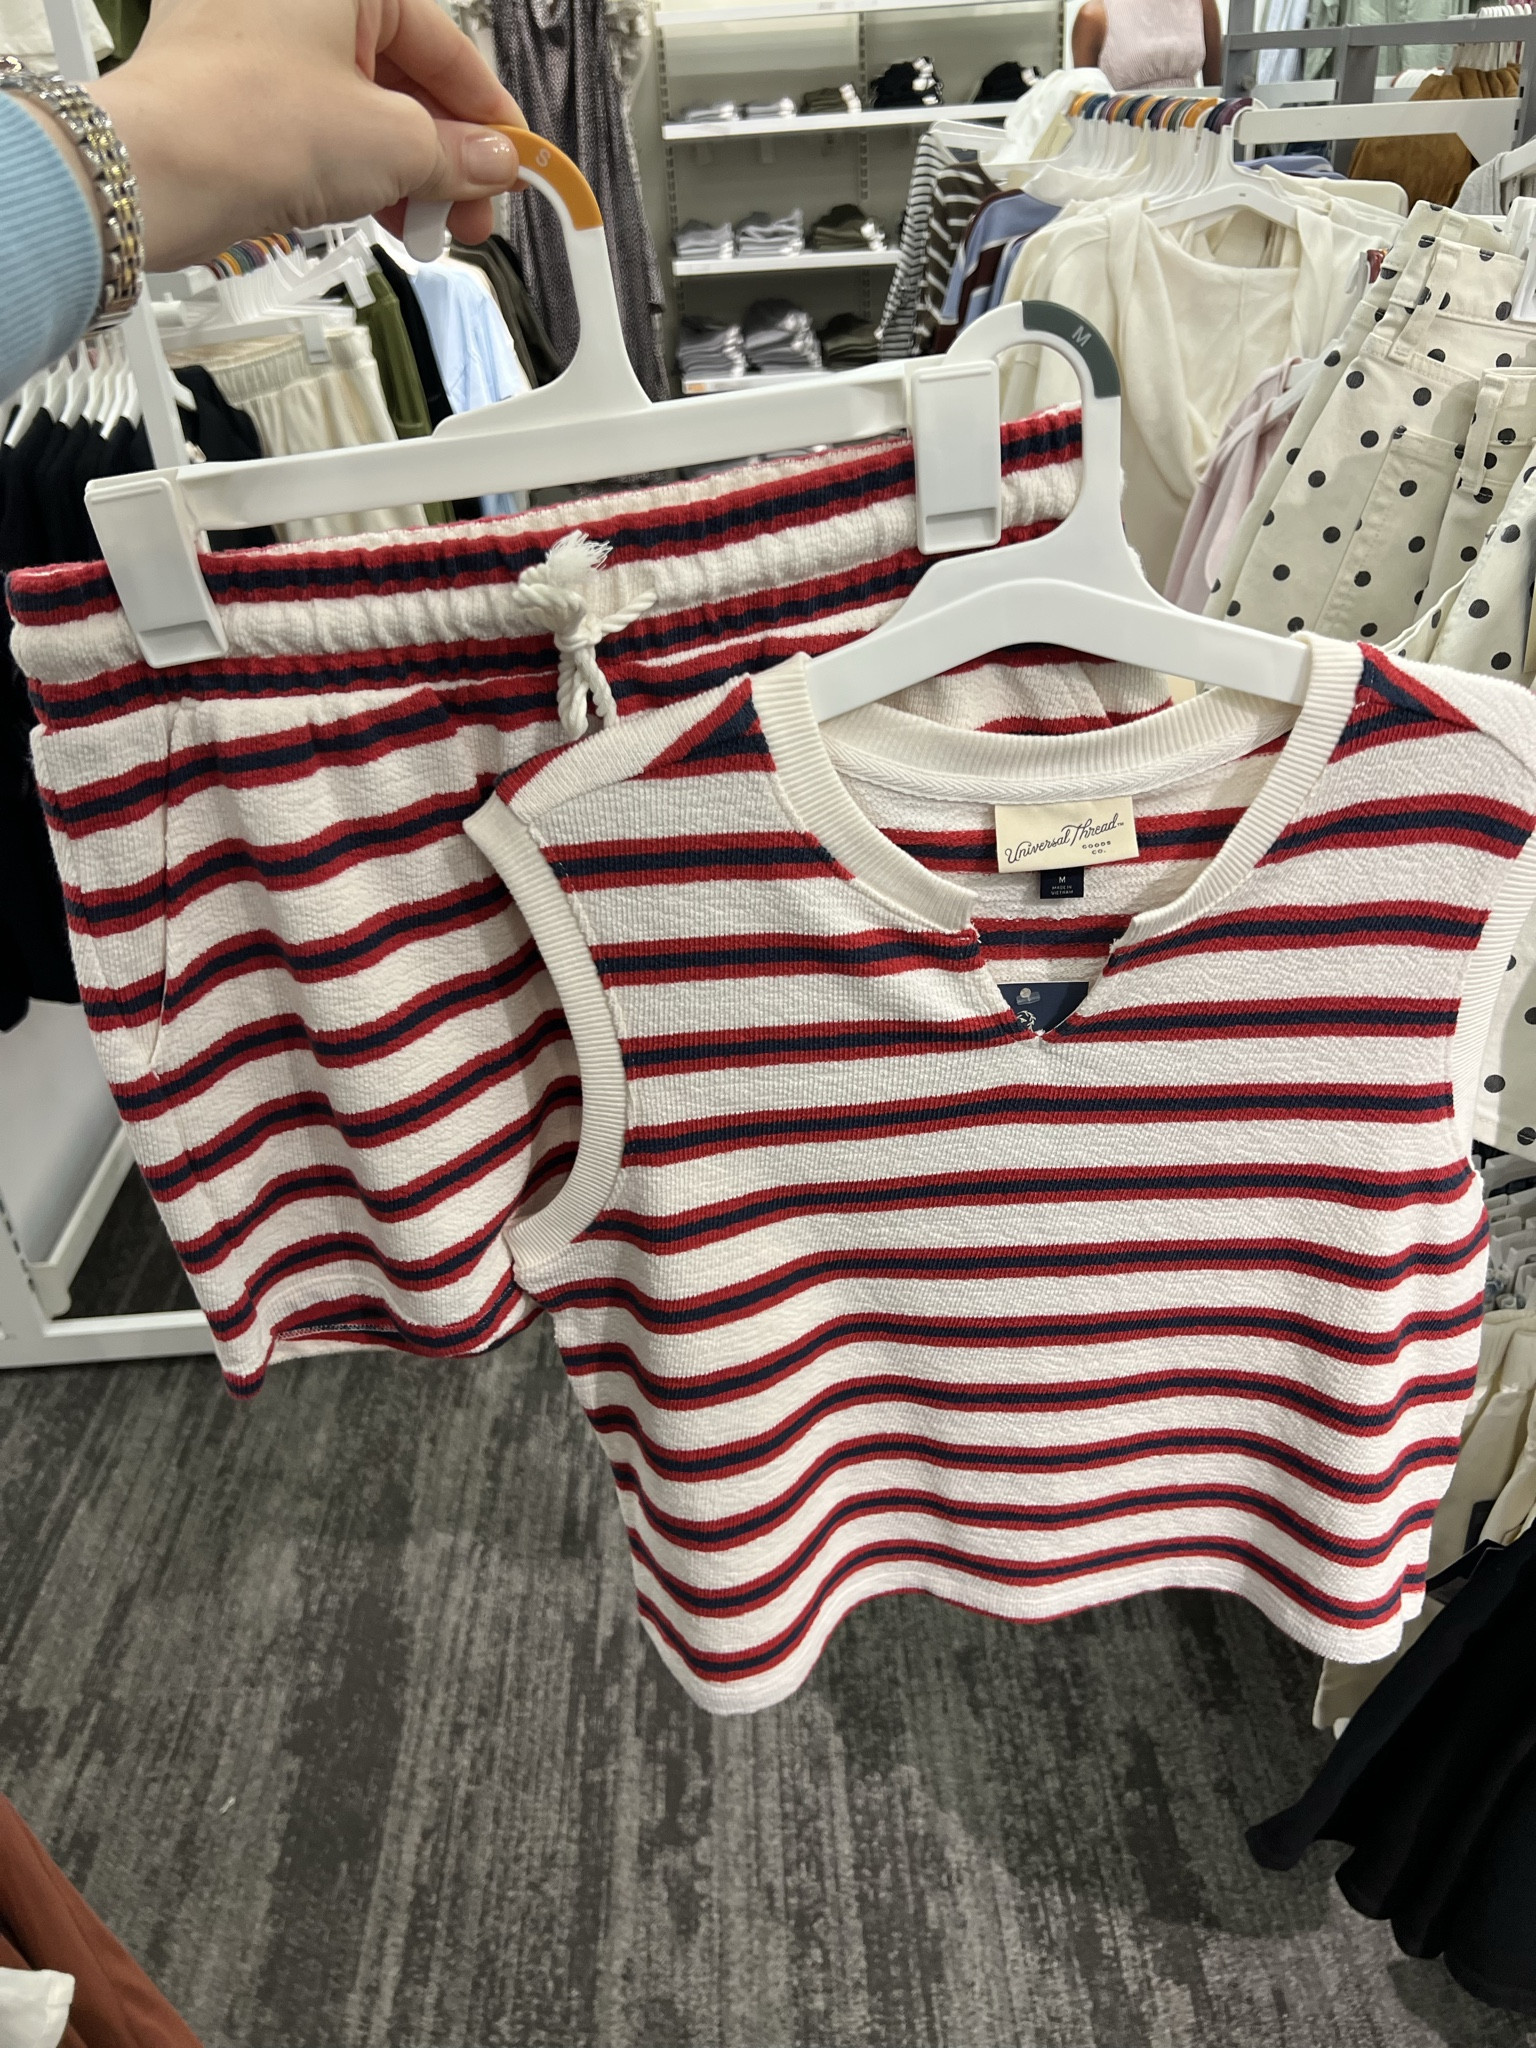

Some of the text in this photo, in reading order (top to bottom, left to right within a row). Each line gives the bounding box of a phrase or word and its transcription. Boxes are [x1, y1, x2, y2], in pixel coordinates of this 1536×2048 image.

[535, 148, 551, 168] S
[1071, 325, 1092, 348] M
[1004, 828, 1071, 864] Universal
[1081, 840, 1111, 850] GOODS
[1058, 875, 1066, 884] M
